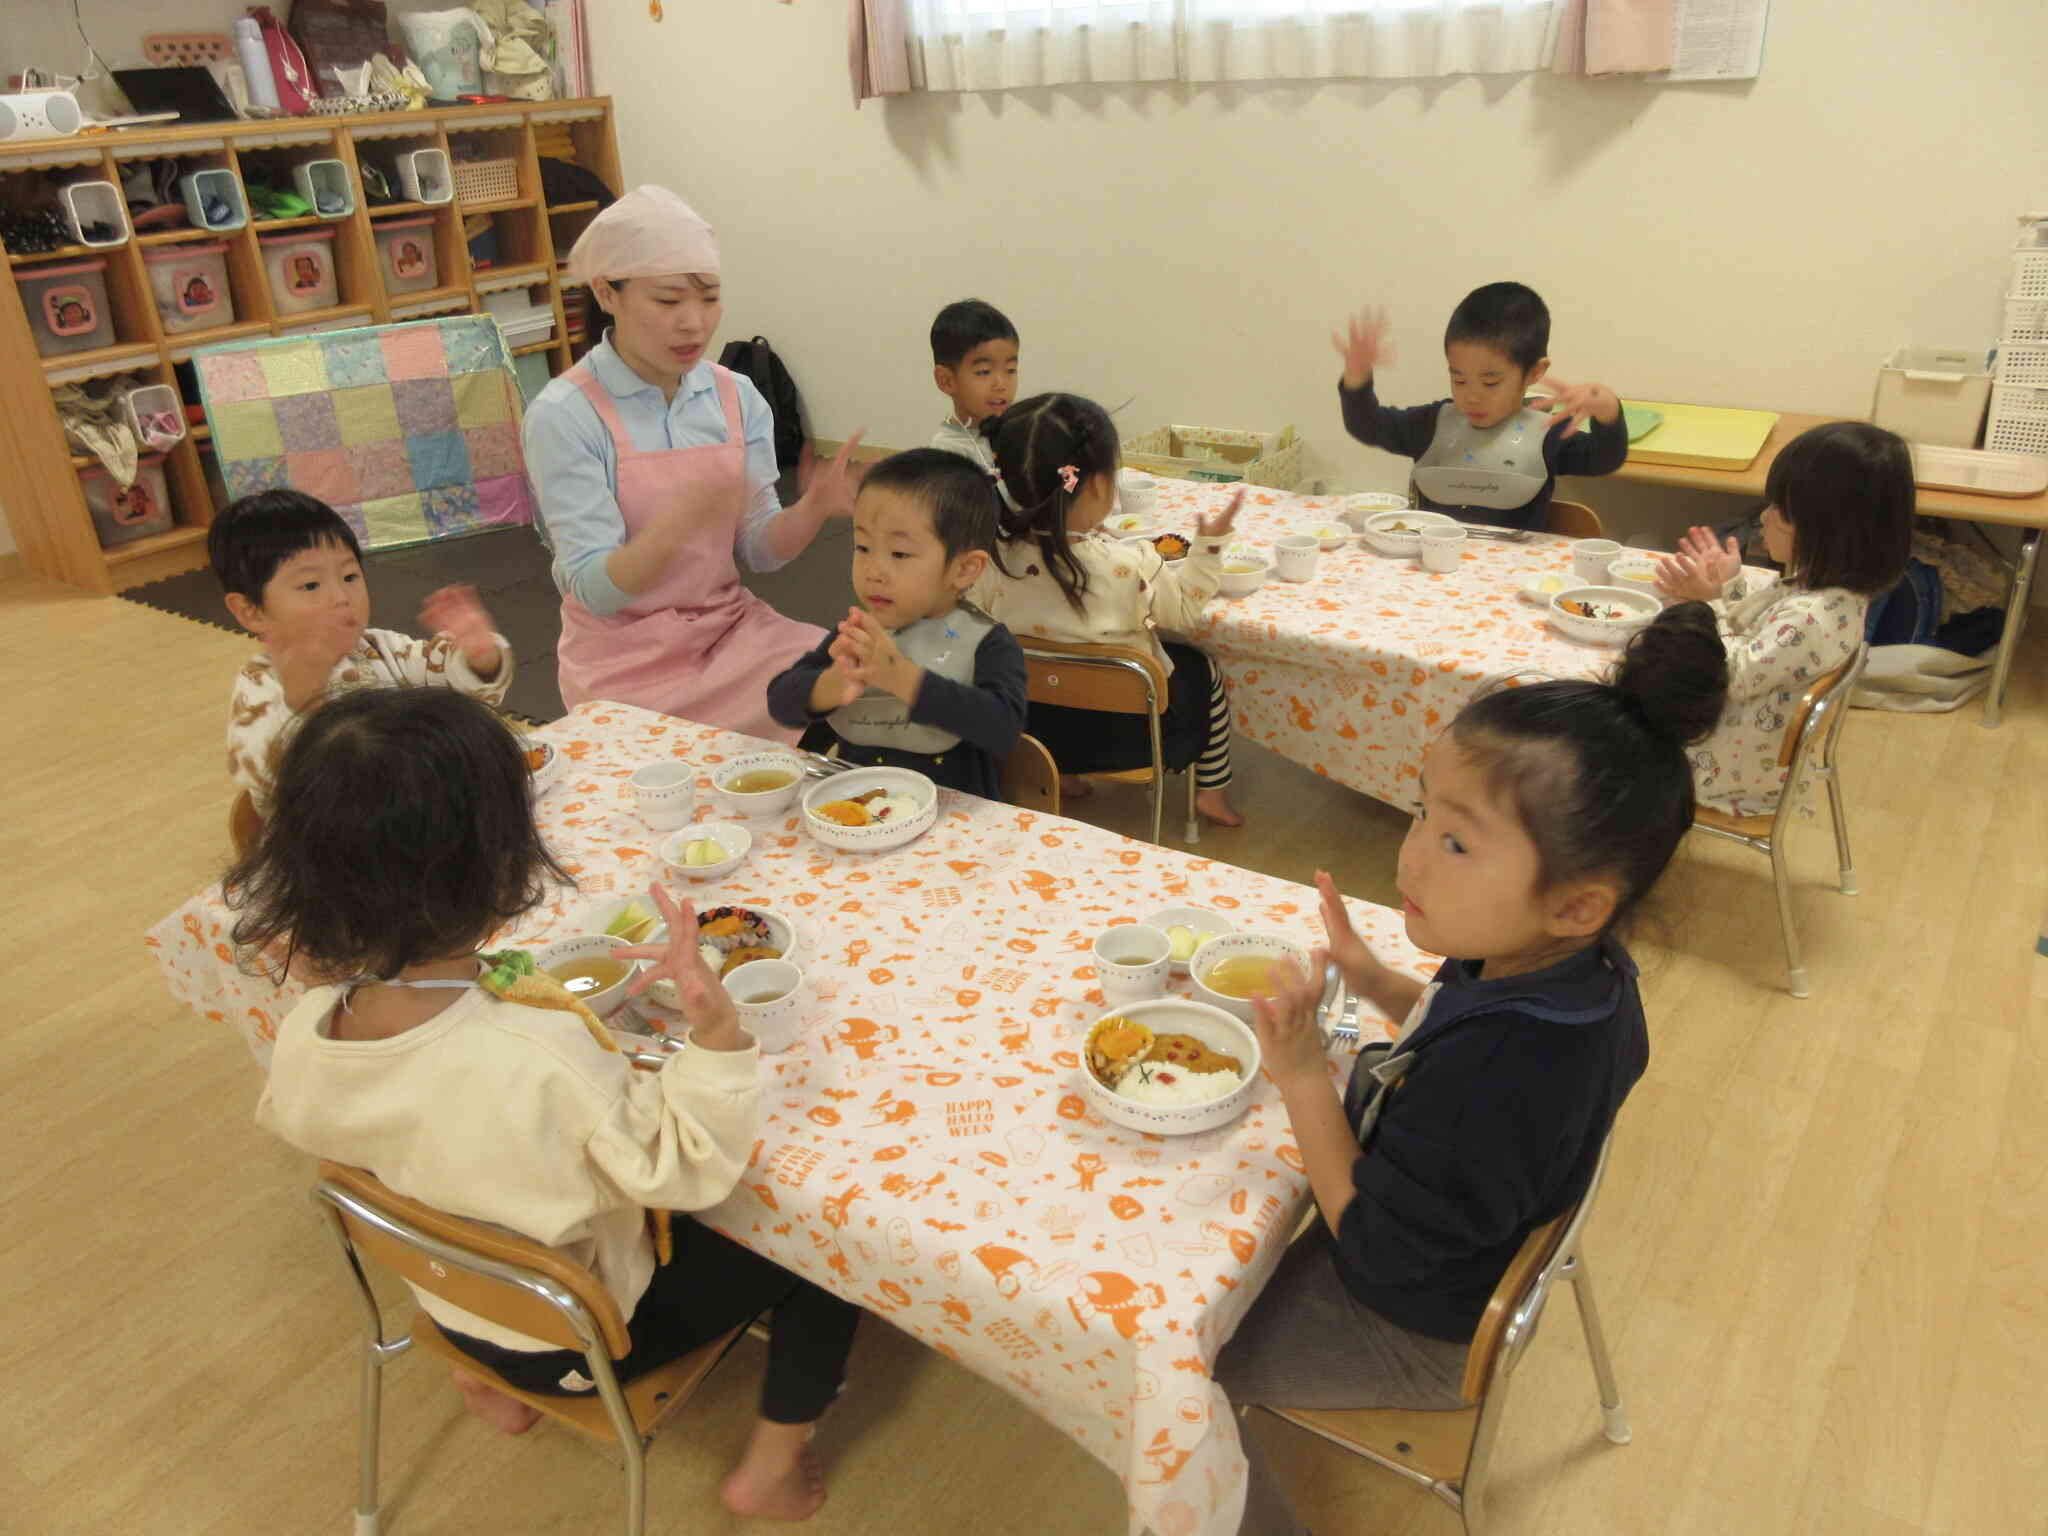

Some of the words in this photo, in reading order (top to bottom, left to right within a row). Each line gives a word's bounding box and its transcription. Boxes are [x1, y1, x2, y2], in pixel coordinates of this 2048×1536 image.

[946, 1099, 993, 1113] HAPPY
[946, 1112, 994, 1126] HALLO
[948, 1124, 993, 1137] WEEN
